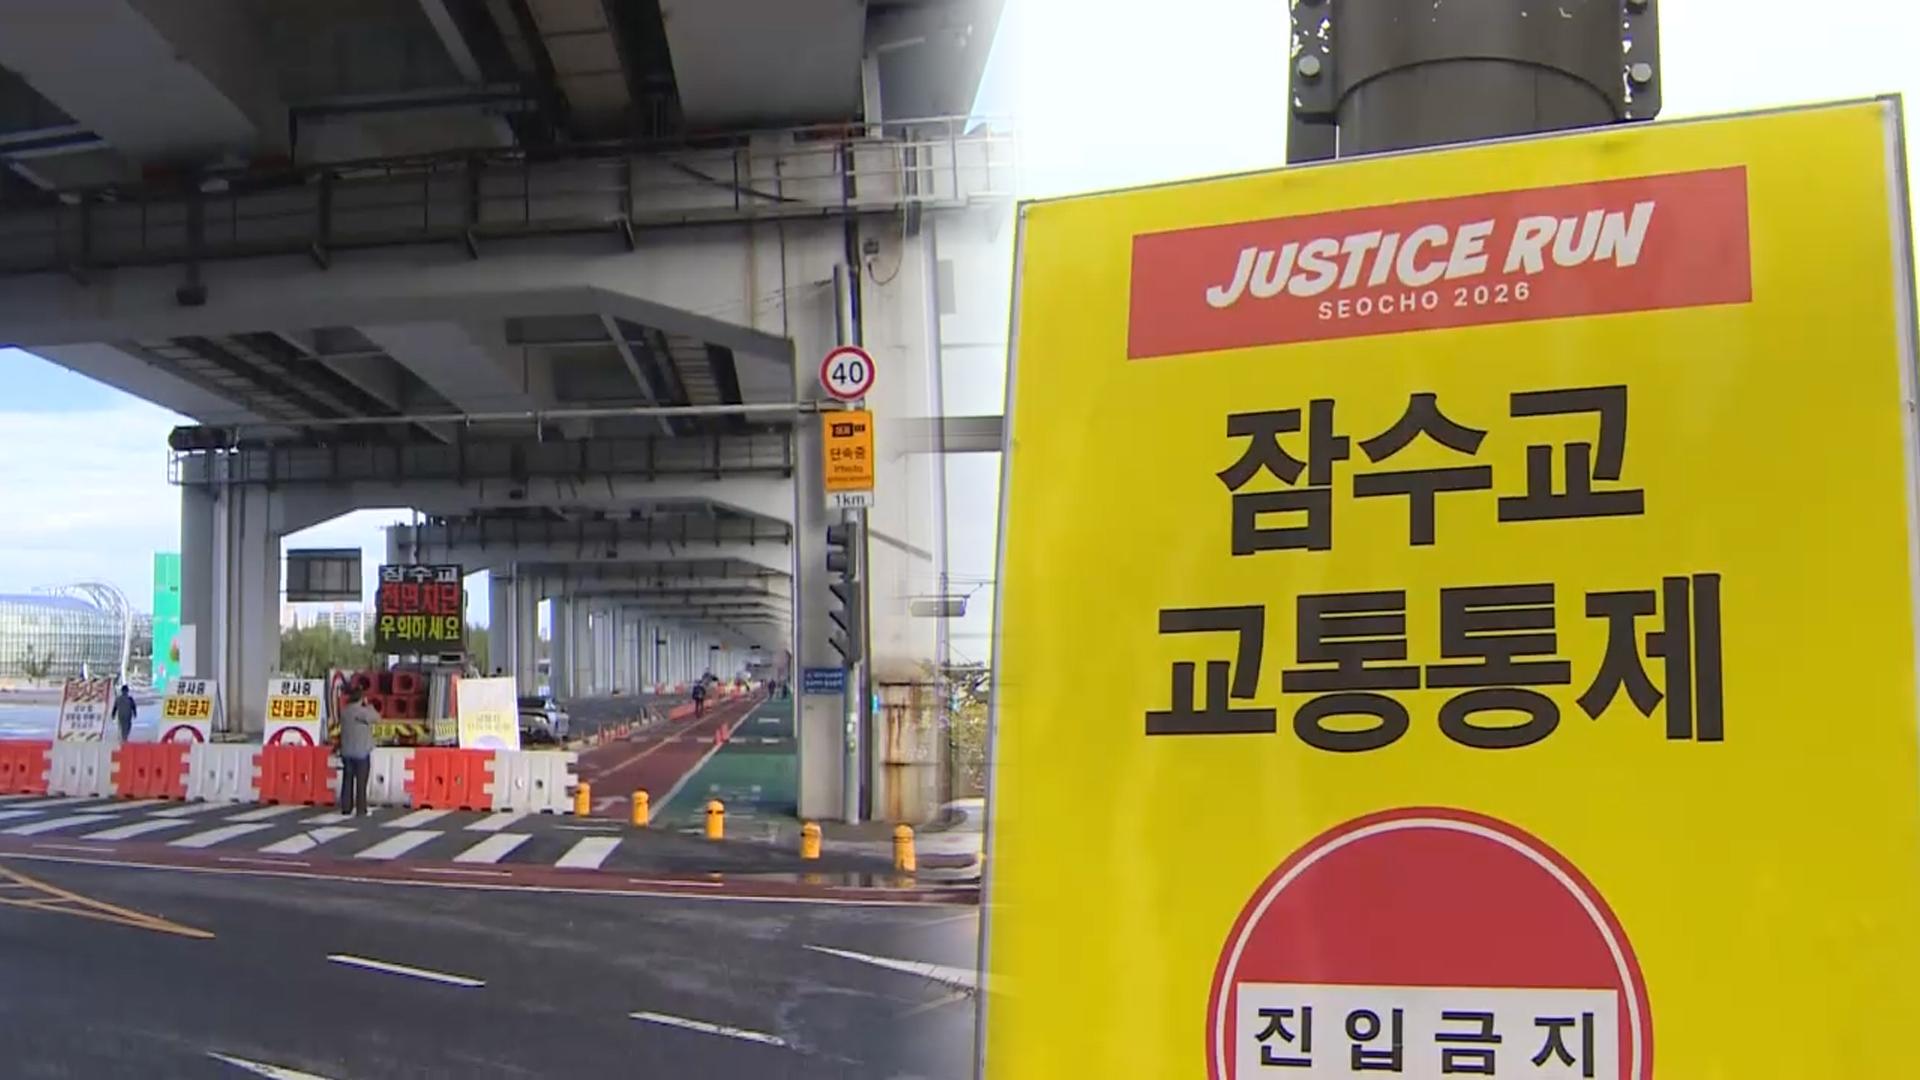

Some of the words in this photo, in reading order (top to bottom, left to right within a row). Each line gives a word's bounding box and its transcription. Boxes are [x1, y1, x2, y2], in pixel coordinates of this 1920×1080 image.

[1205, 219, 1495, 309] JUSTICE
[1503, 201, 1656, 277] RUN
[1317, 290, 1441, 321] SEOCHO
[1453, 281, 1531, 308] 2026
[832, 361, 864, 385] 40
[1216, 384, 1645, 556] 잠수교
[834, 493, 865, 506] 1km
[1144, 573, 1725, 753] 교통통제
[272, 699, 318, 718] 진입금지
[1255, 1006, 1595, 1078] 진입금지
